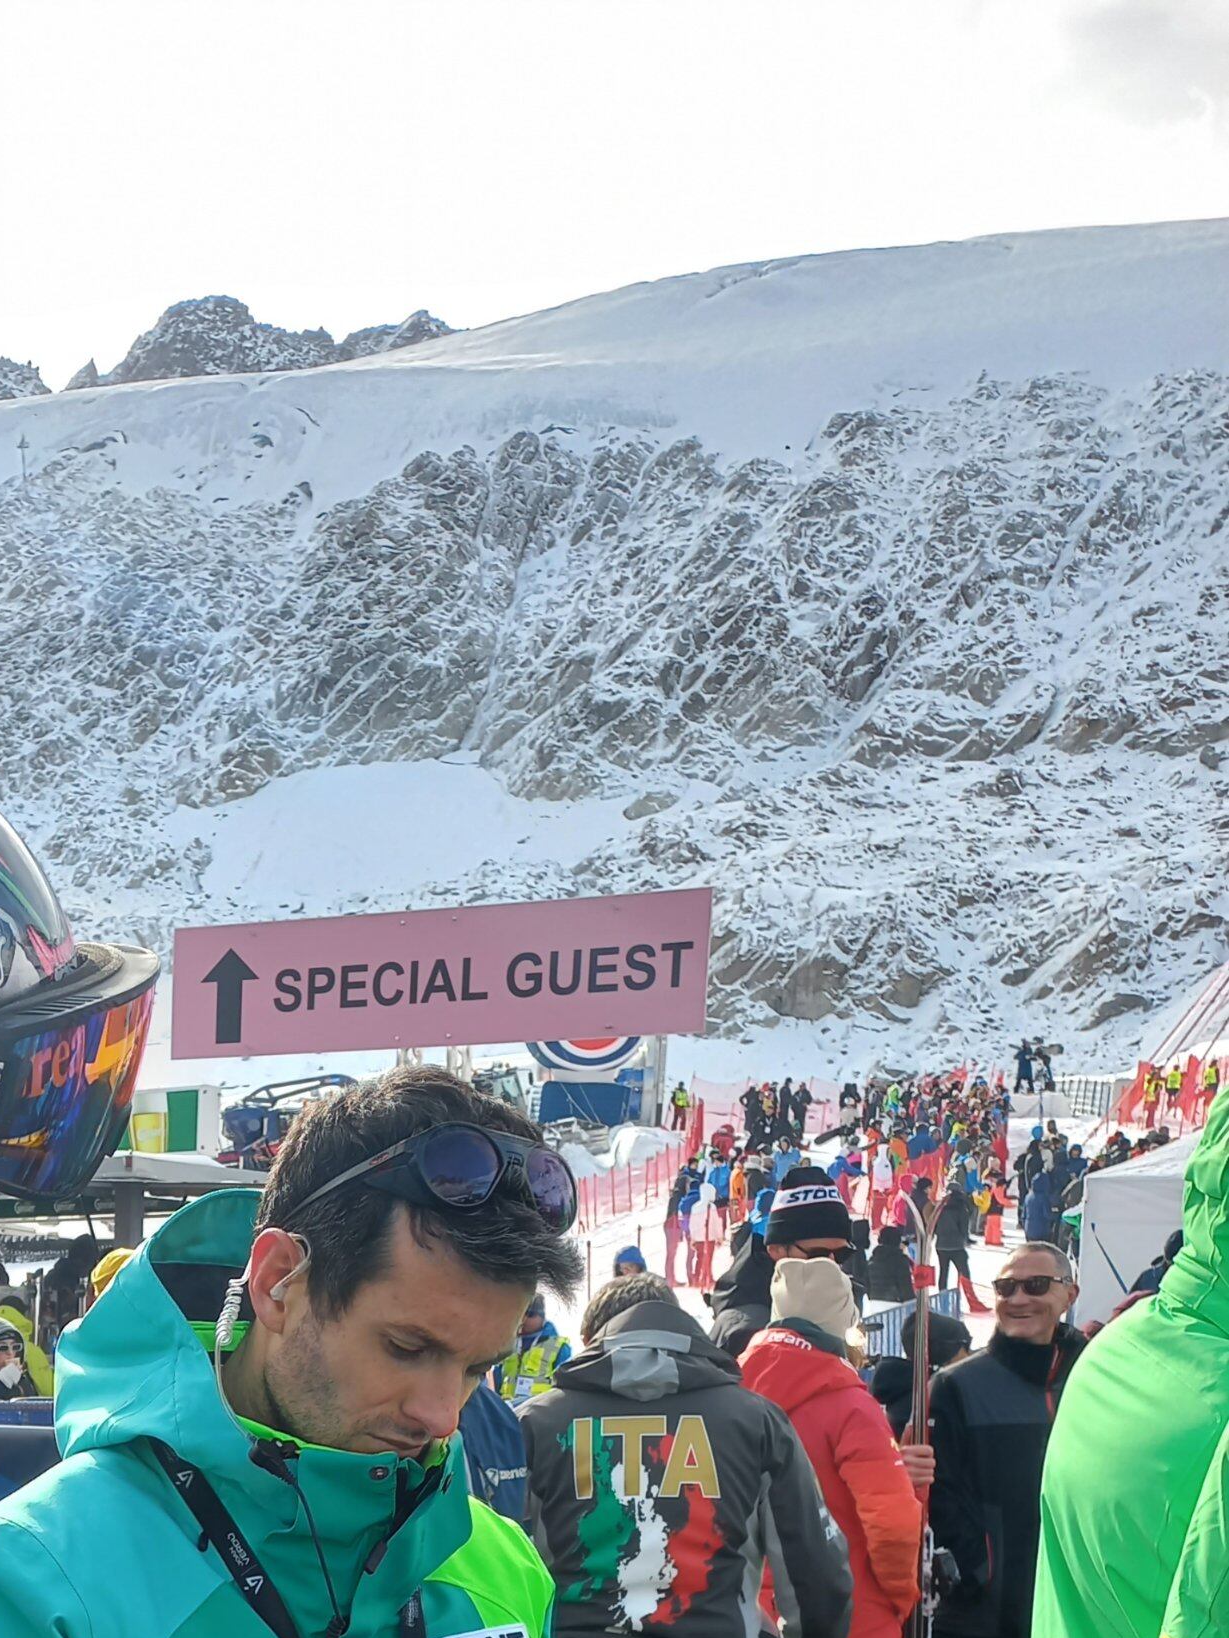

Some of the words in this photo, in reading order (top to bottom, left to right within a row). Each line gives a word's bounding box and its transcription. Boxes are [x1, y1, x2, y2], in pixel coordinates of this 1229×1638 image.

[272, 957, 488, 1013] SPECIAL
[505, 941, 695, 998] GUEST
[572, 1415, 722, 1500] ITA
